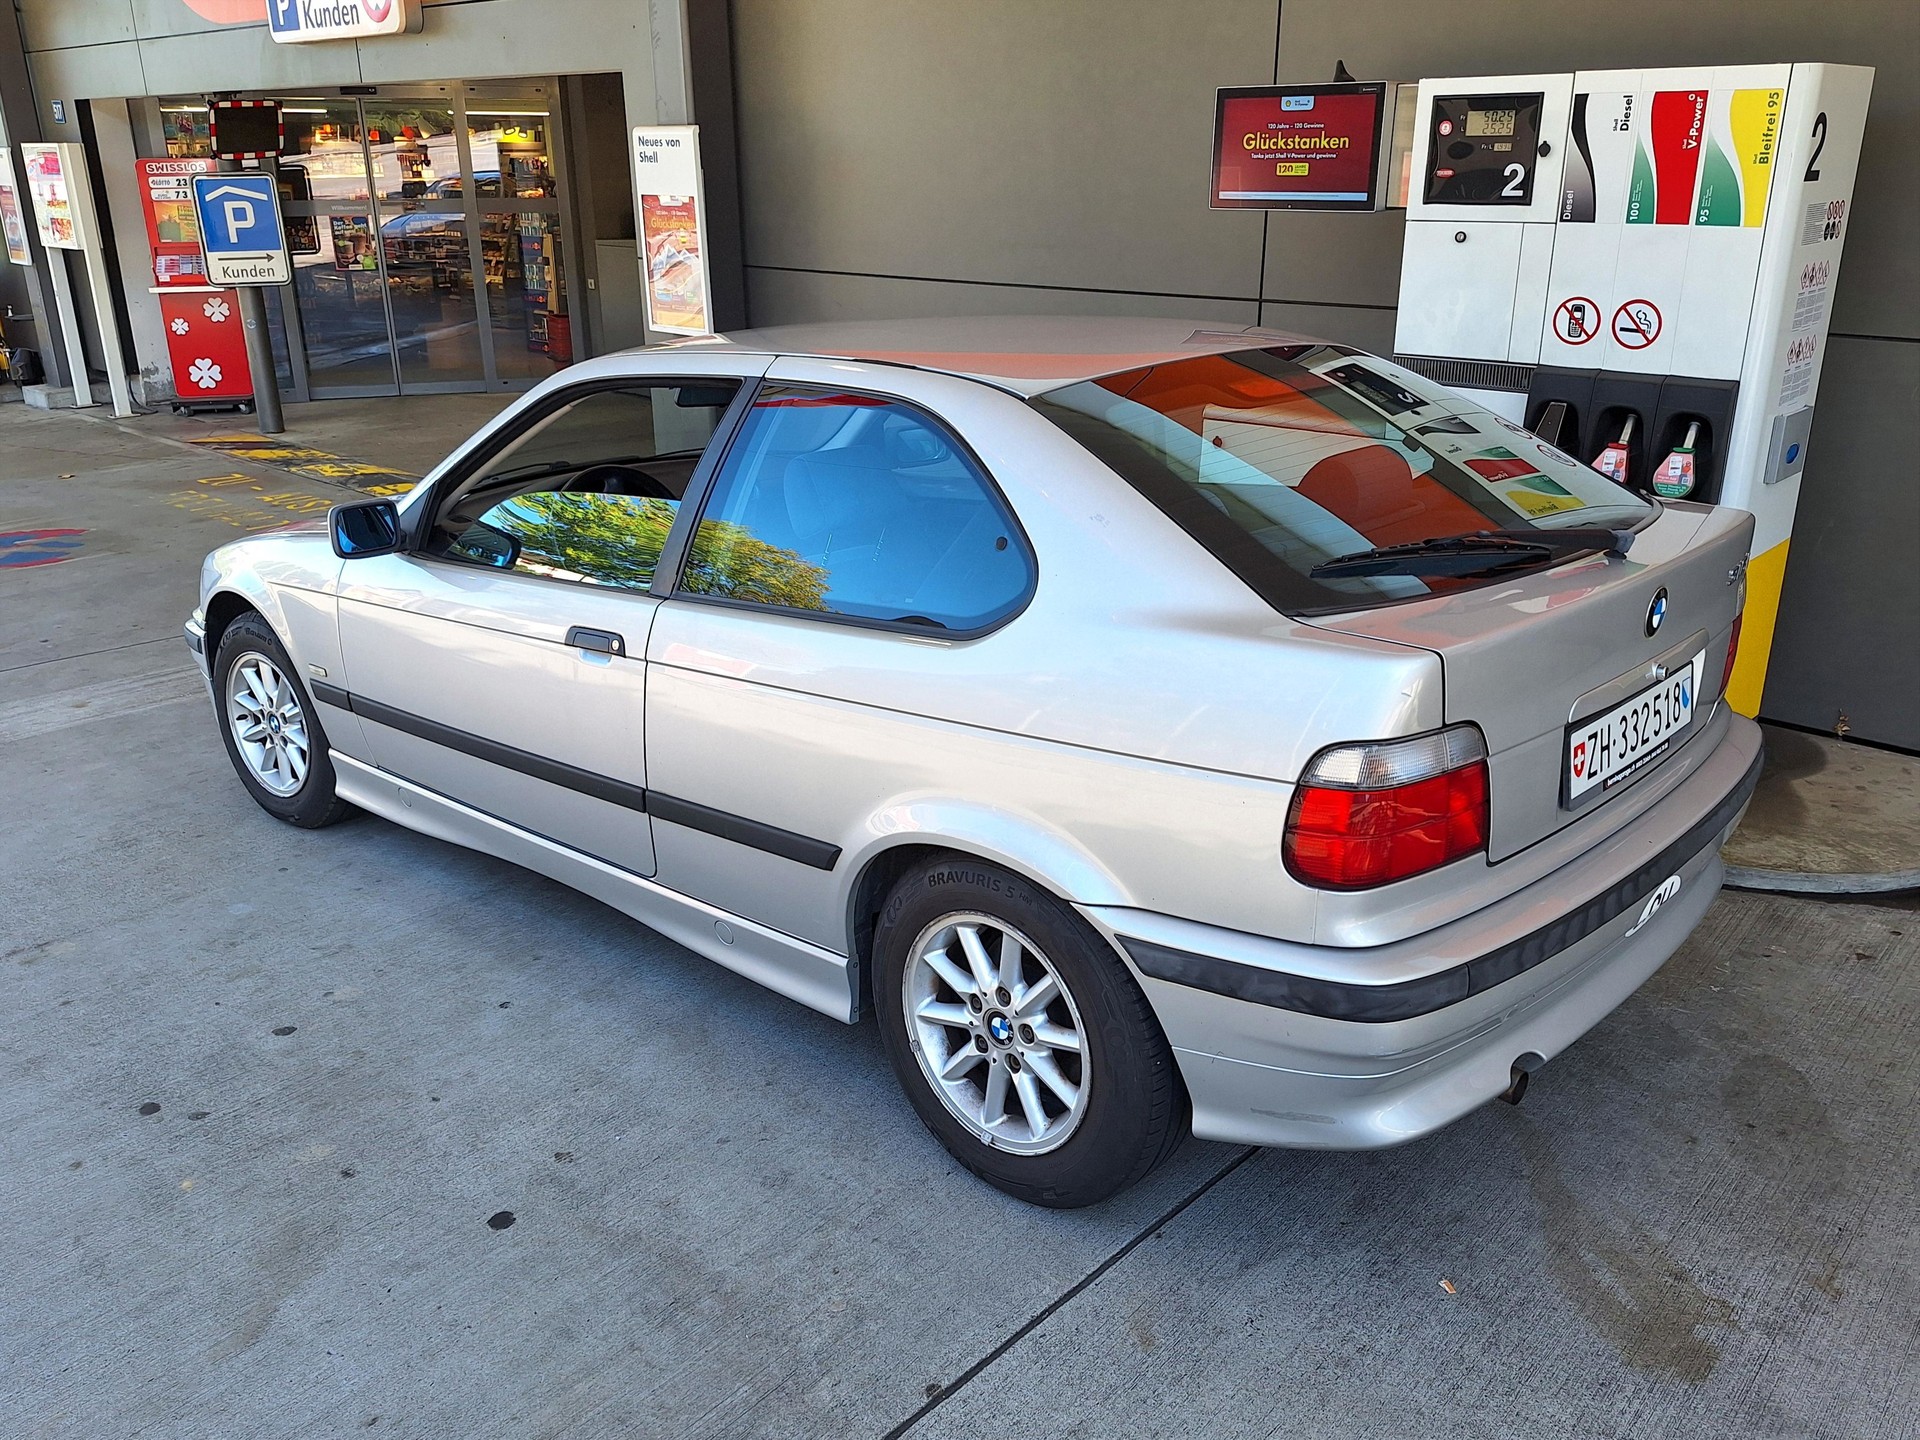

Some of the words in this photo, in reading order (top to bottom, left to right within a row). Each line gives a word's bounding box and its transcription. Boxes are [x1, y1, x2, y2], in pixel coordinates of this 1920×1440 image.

[303, 0, 360, 29] Kunden
[1620, 95, 1633, 131] Diesel
[1687, 96, 1704, 150] V-Power
[1758, 113, 1776, 164] Bleifrei
[1768, 92, 1779, 108] 95
[638, 136, 663, 147] Neues
[665, 138, 680, 147] von
[1243, 131, 1349, 150] Glückstanken
[1803, 112, 1828, 182] 2
[639, 151, 658, 163] Shell
[147, 163, 205, 172] SWISSLOS
[1278, 165, 1293, 174] 120
[1501, 163, 1525, 197] 2
[175, 191, 188, 199] 73
[1563, 190, 1574, 220] Diesel
[1630, 202, 1640, 221] 100
[223, 201, 256, 243] P
[1699, 209, 1709, 222] 95
[222, 265, 275, 279] Kunden
[245, 627, 267, 642] Barum
[928, 871, 1001, 892] BRAVURIS
[1005, 886, 1015, 898] 5
